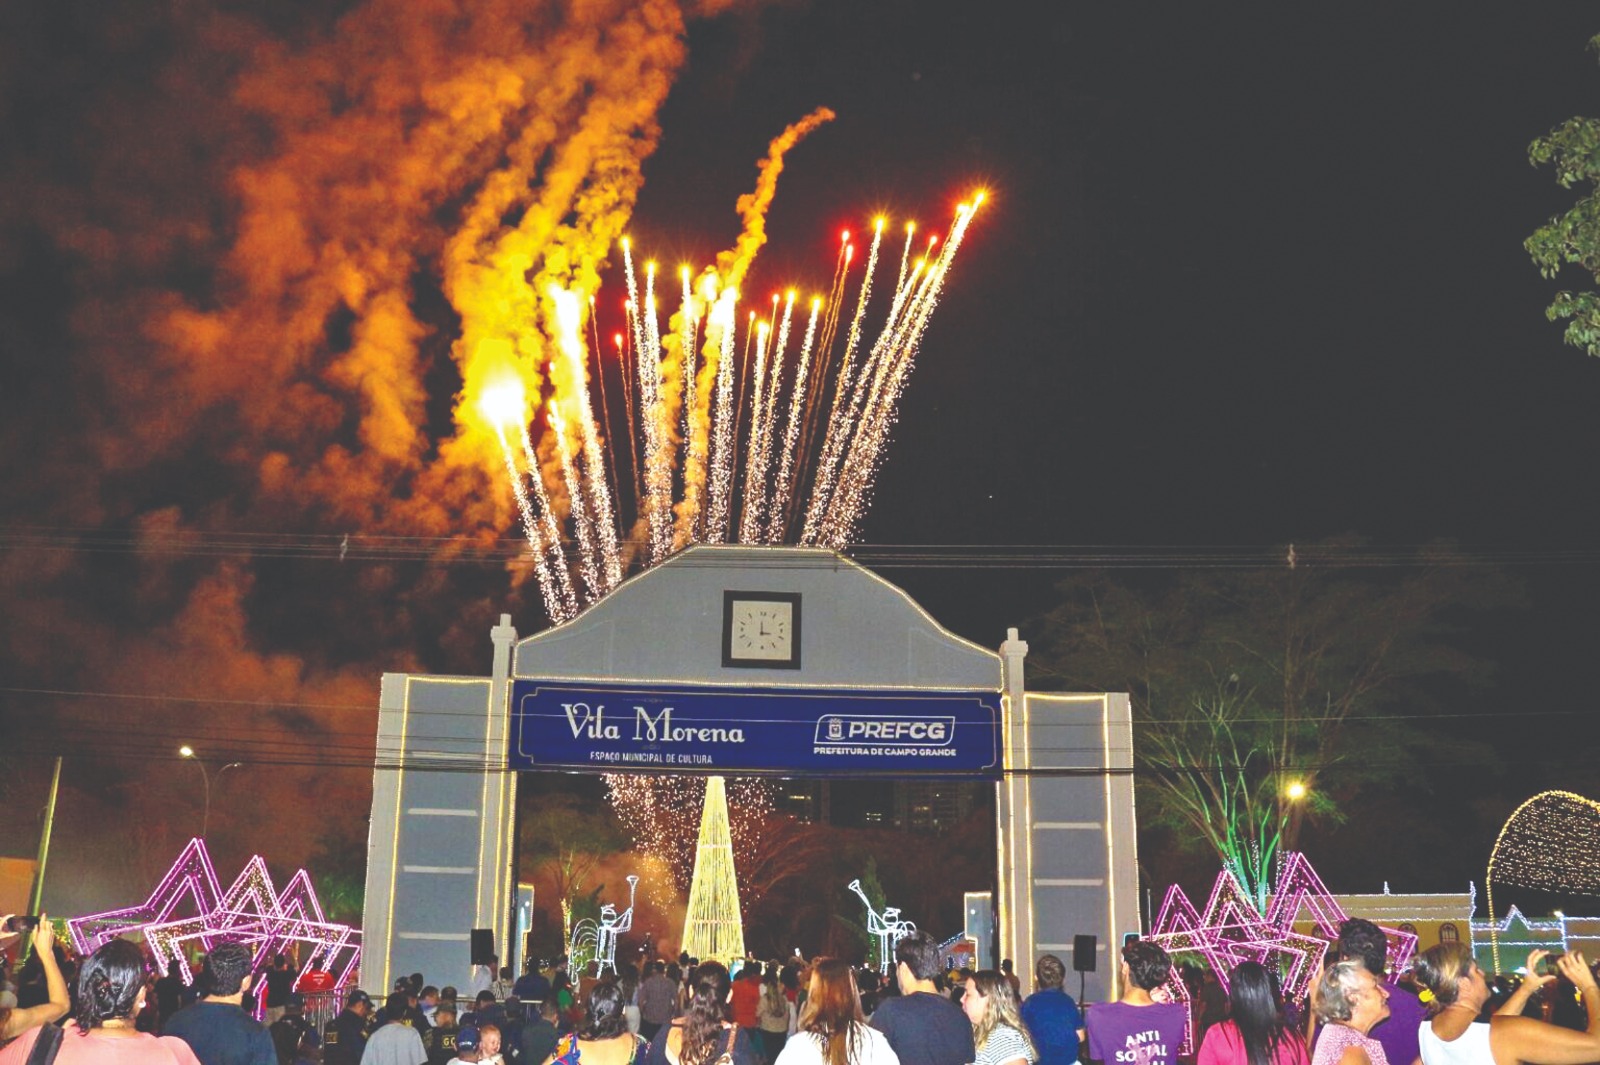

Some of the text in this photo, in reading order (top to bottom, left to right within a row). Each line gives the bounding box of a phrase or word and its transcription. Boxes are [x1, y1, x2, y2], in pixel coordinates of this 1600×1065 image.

[561, 702, 746, 743] Vila Morena
[848, 721, 945, 739] PREFCG
[590, 751, 713, 765] ESPAÇO MUNICIPAL DE CULTURA
[813, 747, 957, 757] PREFEITURA DE CAMPO GRANDE
[1125, 1030, 1160, 1047] ANTI
